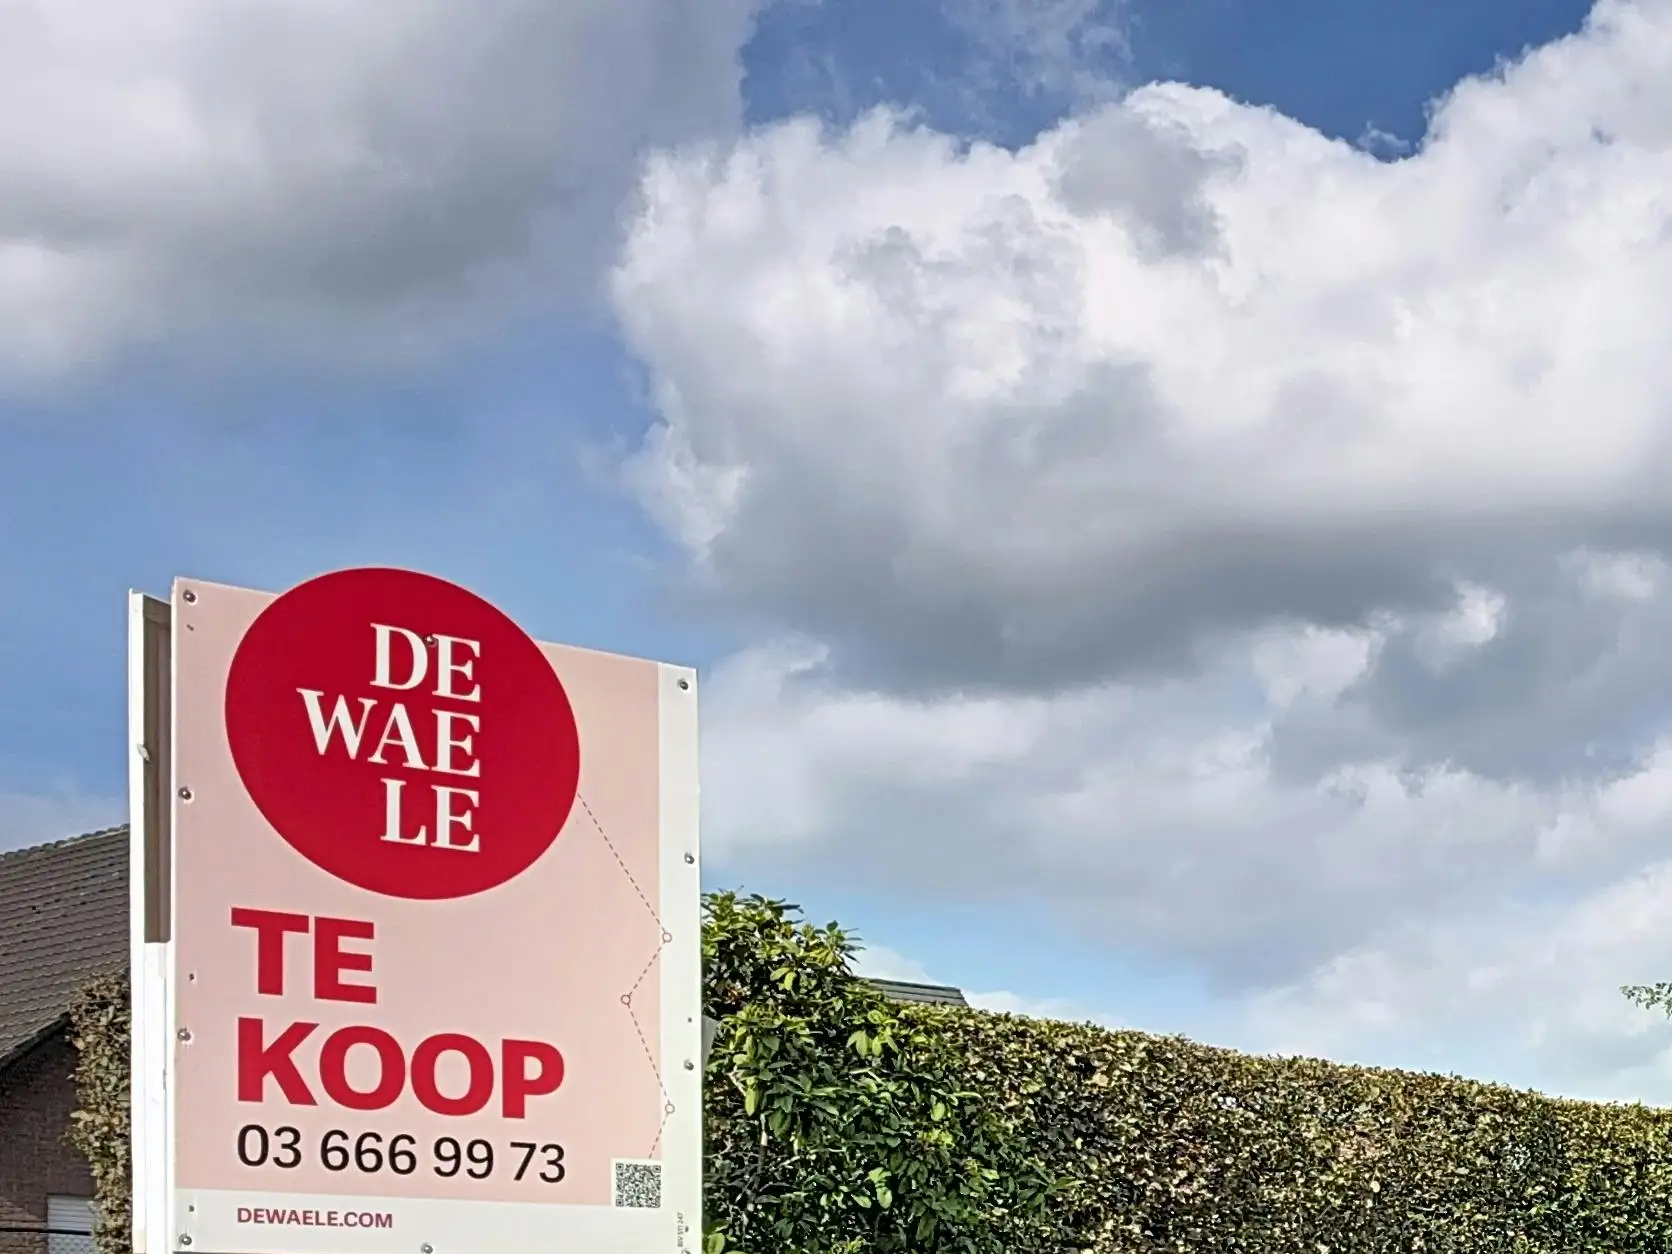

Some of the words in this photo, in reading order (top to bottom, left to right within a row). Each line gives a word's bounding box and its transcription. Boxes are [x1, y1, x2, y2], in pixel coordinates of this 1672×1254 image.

[370, 624, 480, 702] DE
[297, 688, 480, 777] WAE
[381, 779, 480, 852] LE
[231, 908, 377, 1004] TE
[238, 1018, 565, 1119] KOOP
[237, 1124, 302, 1168] 03
[320, 1129, 417, 1175] 666
[433, 1137, 494, 1179] 99
[510, 1142, 565, 1183] 73
[237, 1207, 393, 1229] DEWAELE.COM
